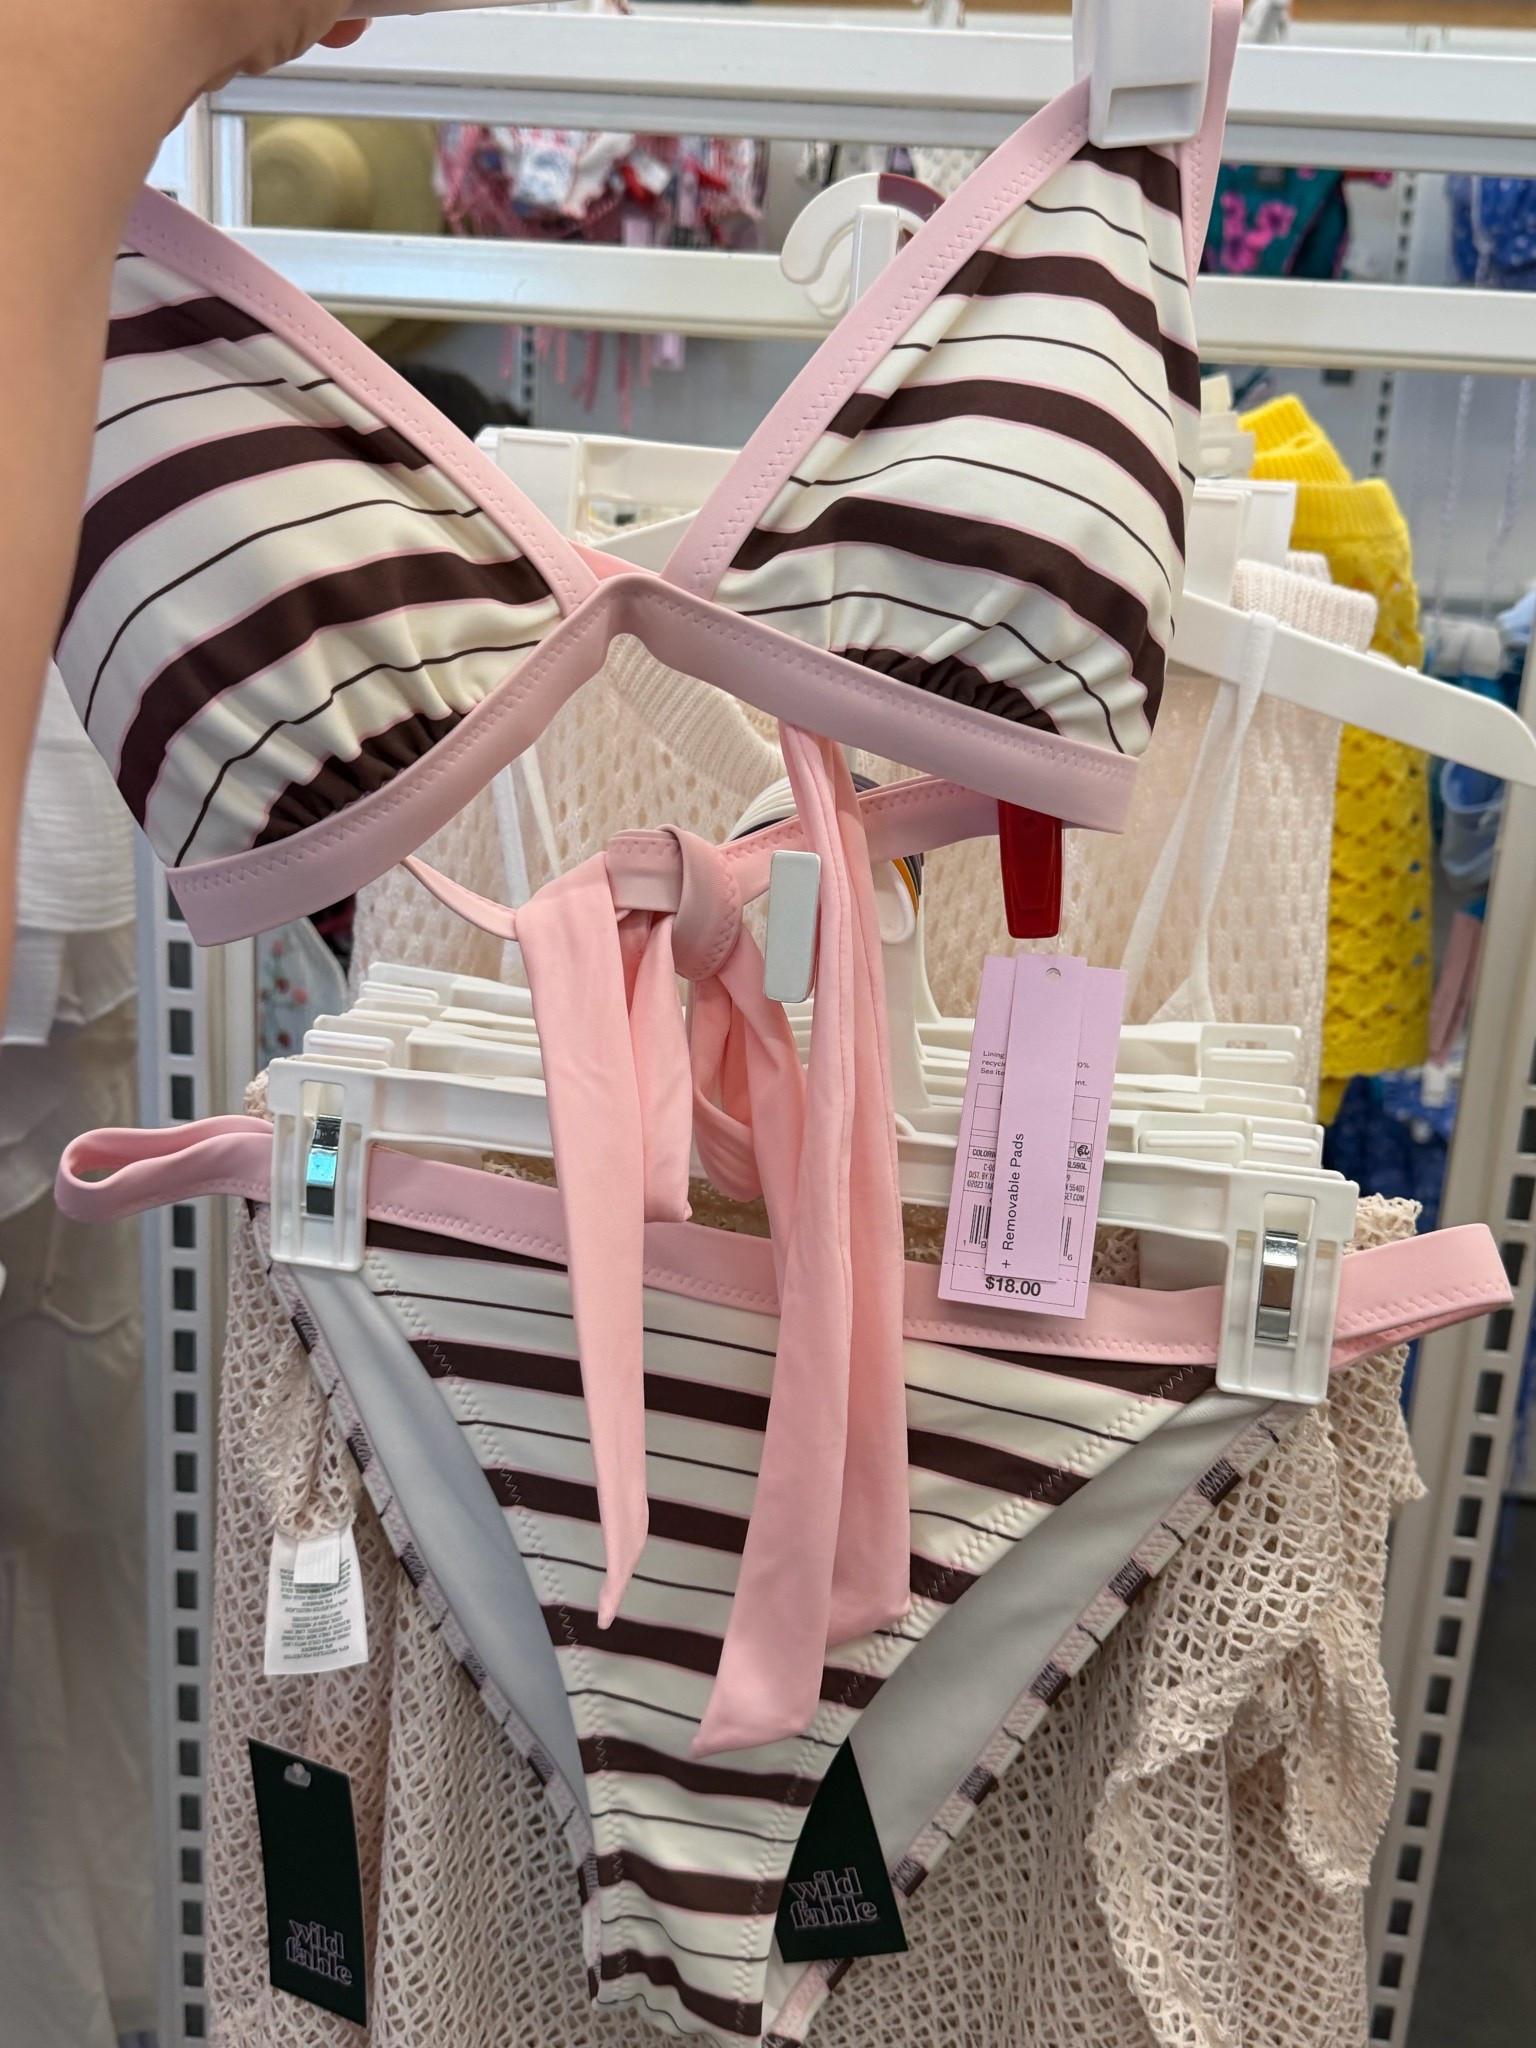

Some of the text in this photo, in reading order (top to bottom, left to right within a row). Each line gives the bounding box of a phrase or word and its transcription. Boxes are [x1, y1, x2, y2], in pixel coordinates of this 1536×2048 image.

[980, 1067, 994, 1075] See
[983, 1050, 1005, 1060] Lining
[1009, 1133, 1024, 1168] Pads
[1002, 1172, 1020, 1250] Removable
[985, 1275, 1042, 1297] $18.00
[788, 1866, 863, 1901] wild
[789, 1895, 878, 1929] fable
[288, 1919, 345, 1960] wild
[285, 1936, 353, 1985] fable
